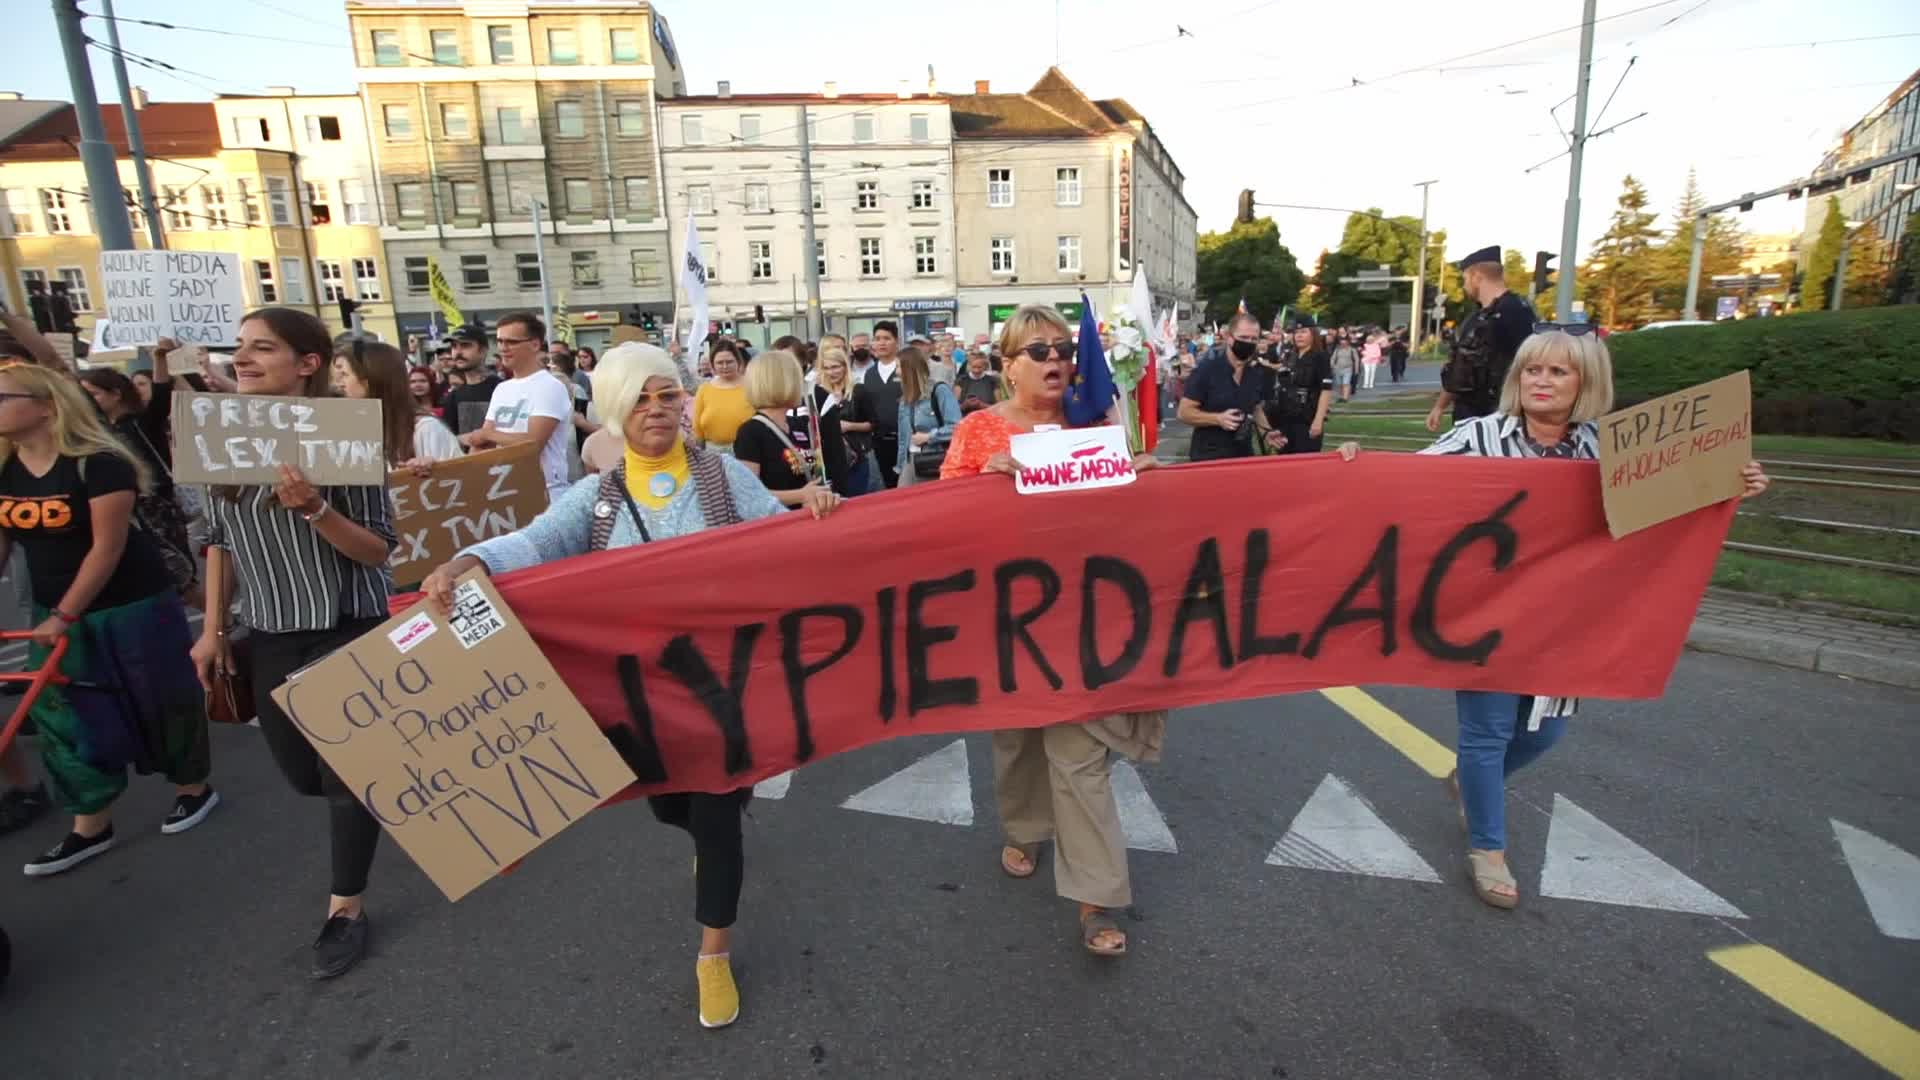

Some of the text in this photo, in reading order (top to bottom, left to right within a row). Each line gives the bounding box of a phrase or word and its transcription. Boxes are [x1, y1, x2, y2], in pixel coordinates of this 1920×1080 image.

[104, 253, 228, 276] WOLNE MEDIA
[106, 277, 154, 299] WOLNE
[109, 303, 233, 323] WOLNI LUDZIE
[174, 325, 224, 343] KRAJ
[191, 396, 318, 432] PRECZ
[194, 433, 281, 472] LEX
[1608, 411, 1748, 489] #WOLNE MEDIA!
[1020, 461, 1079, 487] WOLNE
[388, 478, 467, 521] ECZ
[386, 505, 518, 568] EX TVN
[462, 617, 502, 646] MEDIA
[428, 737, 601, 866] TVN
